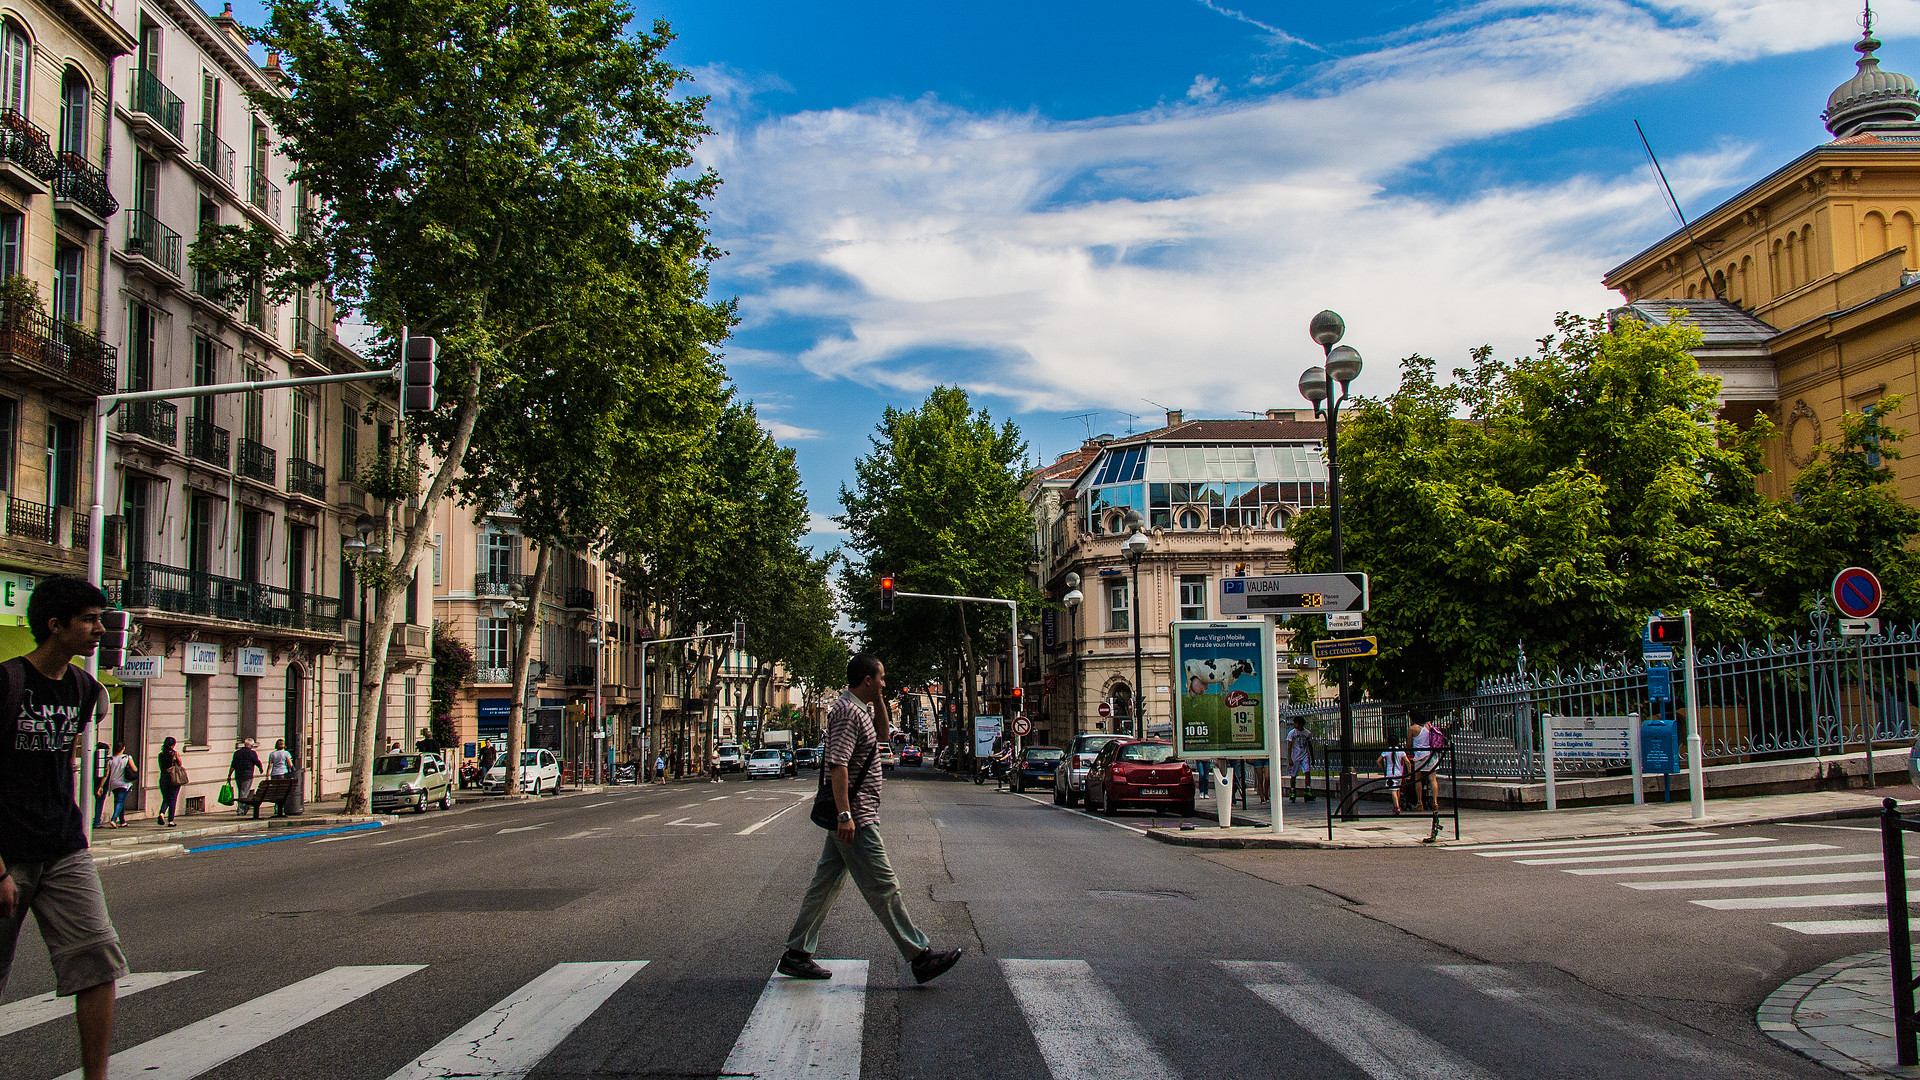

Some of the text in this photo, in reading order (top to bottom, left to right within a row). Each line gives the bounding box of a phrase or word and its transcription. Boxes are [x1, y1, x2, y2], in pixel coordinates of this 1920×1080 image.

[1246, 581, 1279, 592] VAUBAN
[1301, 593, 1323, 608] 30
[1208, 634, 1225, 642] Virgin
[192, 646, 216, 663] L'avenir
[1329, 647, 1362, 655] CITADINES
[244, 650, 264, 665] L'avenir
[1233, 711, 1247, 724] 19
[1185, 725, 1208, 736] 10 05
